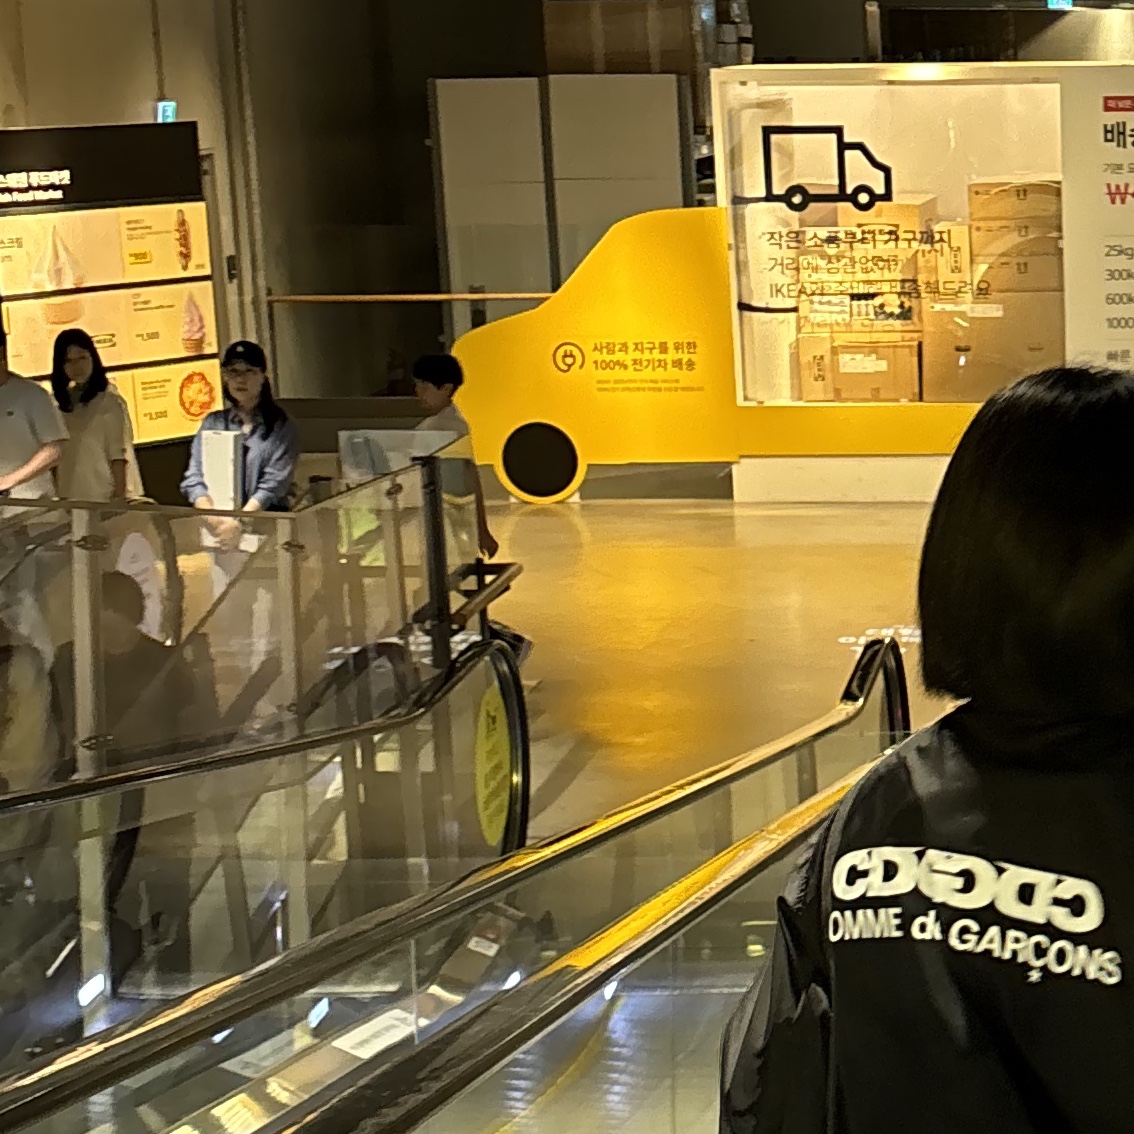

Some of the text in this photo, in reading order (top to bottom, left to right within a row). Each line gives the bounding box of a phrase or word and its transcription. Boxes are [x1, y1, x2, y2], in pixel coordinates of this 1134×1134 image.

[767, 231, 800, 249] 작은
[1104, 244, 1134, 260] 25kg
[632, 341, 669, 355] 지구를
[673, 341, 697, 355] 위한
[593, 359, 628, 371] 100%
[671, 358, 696, 371] 배송
